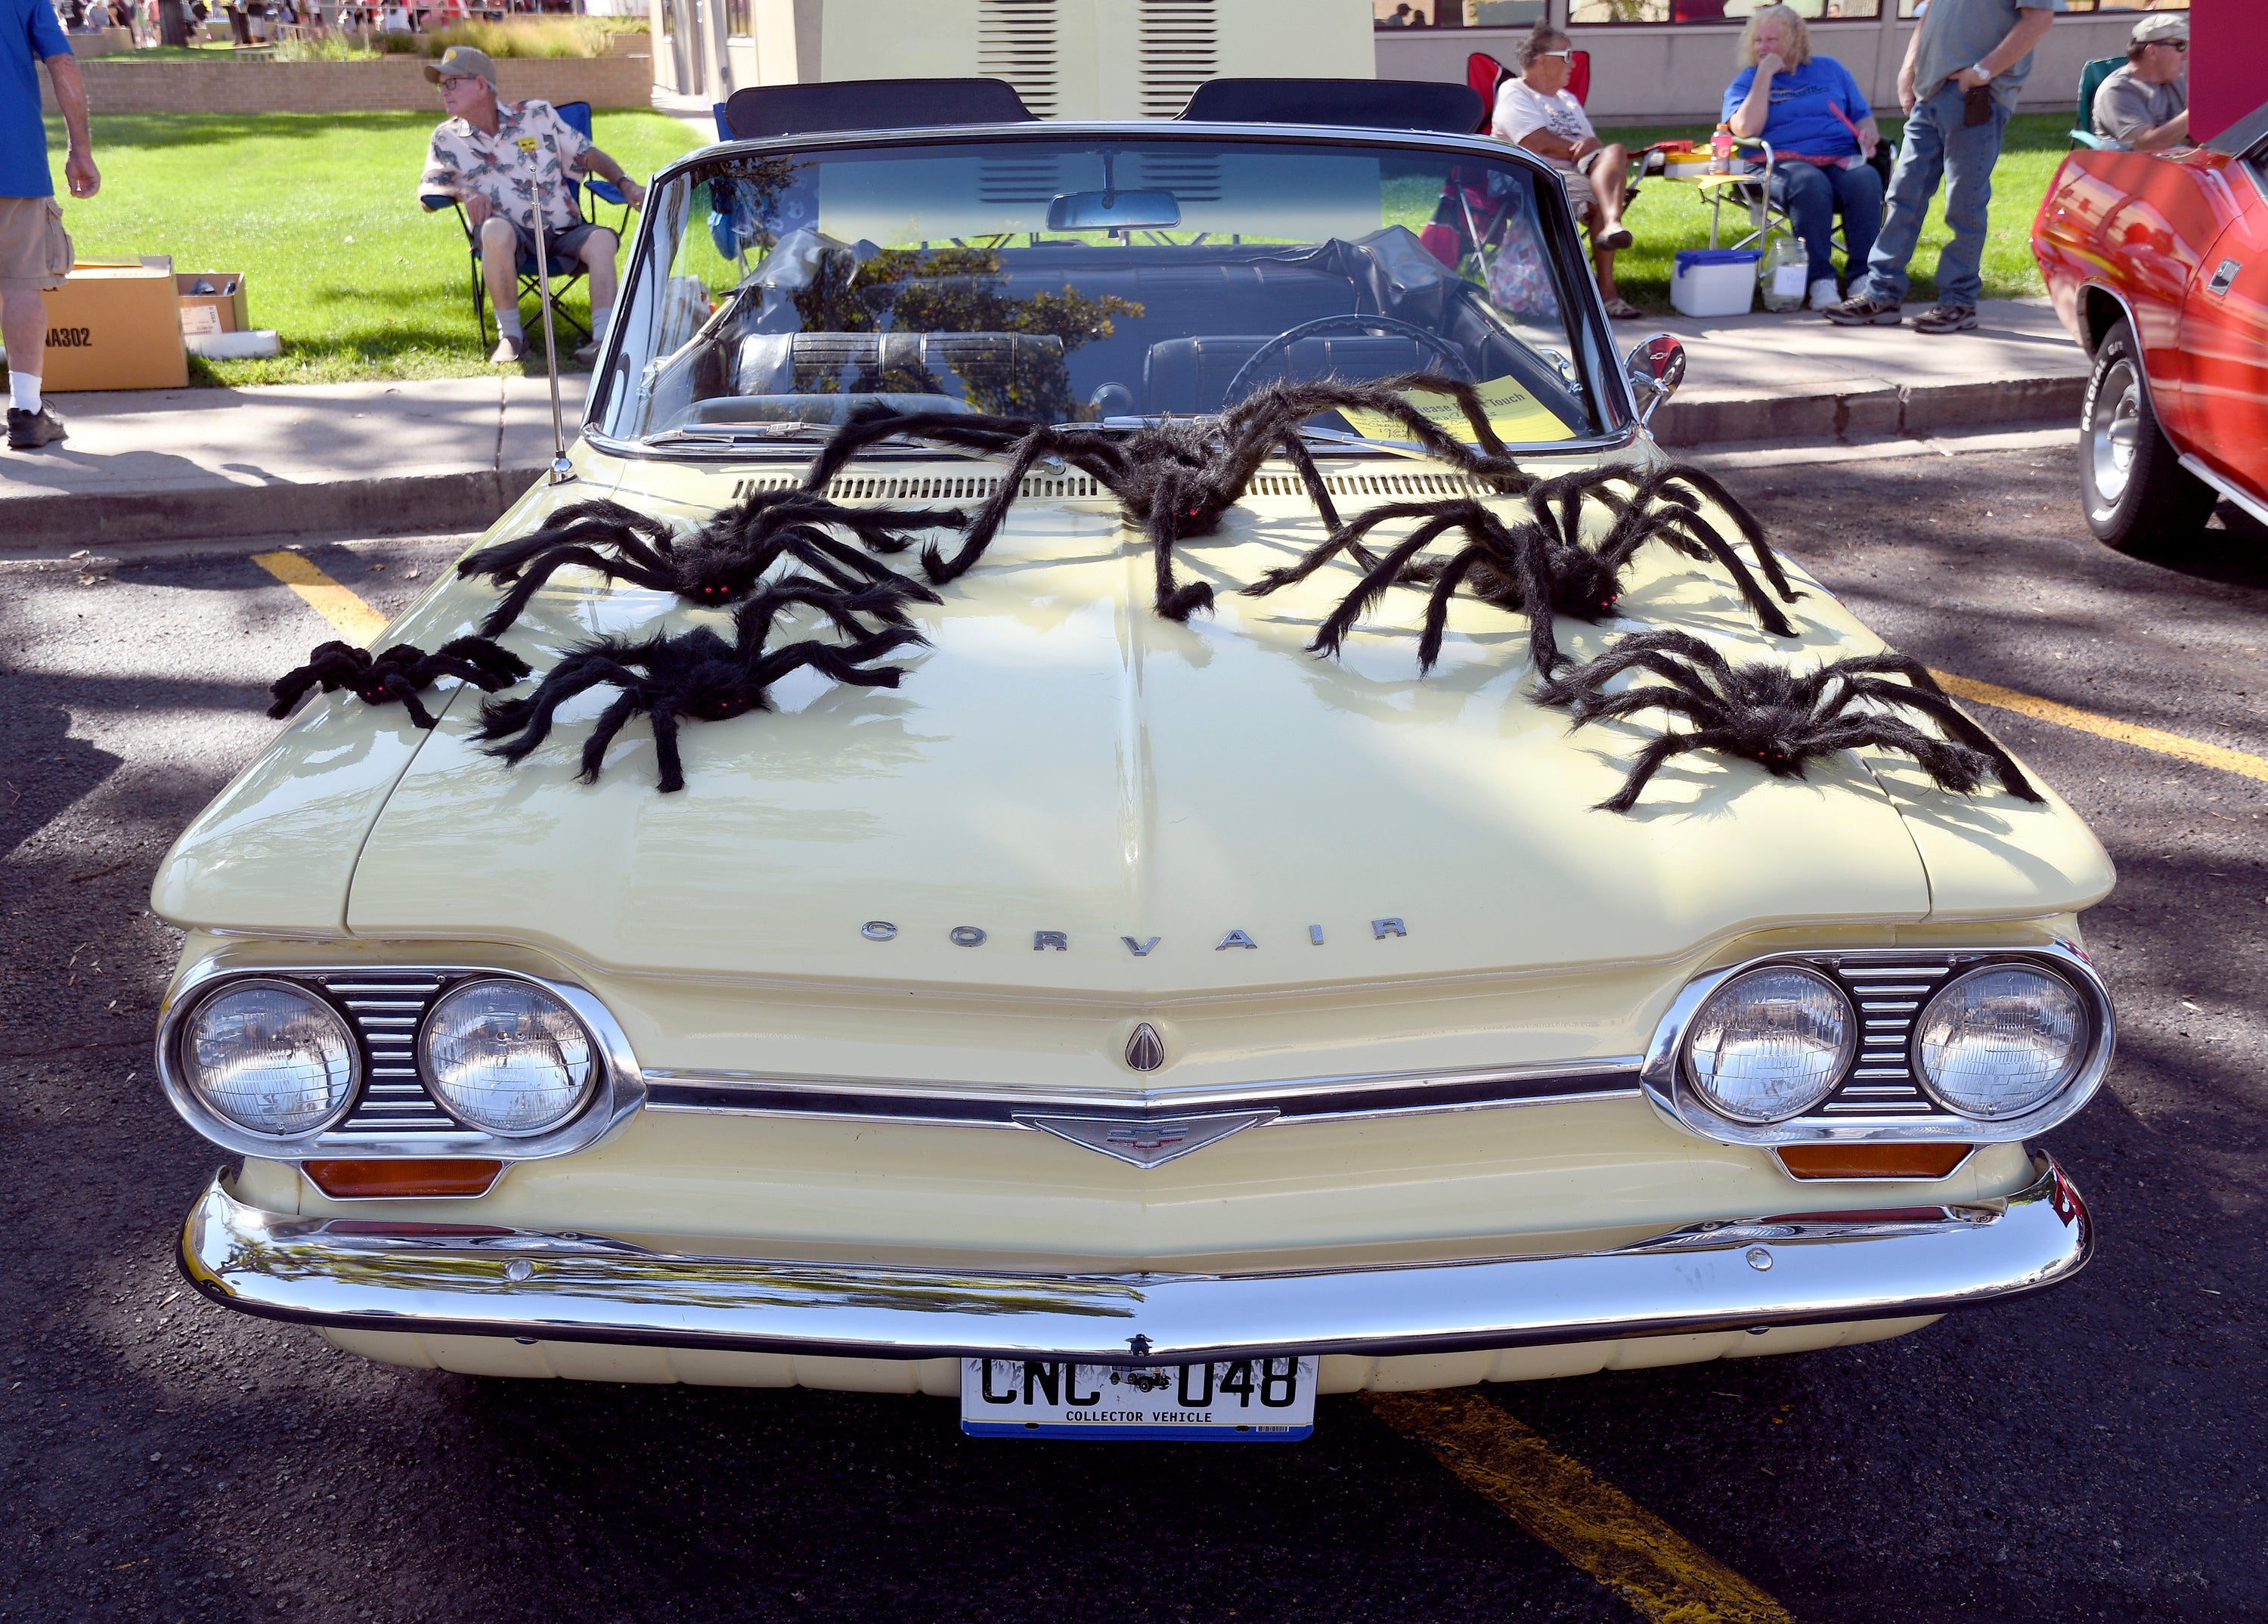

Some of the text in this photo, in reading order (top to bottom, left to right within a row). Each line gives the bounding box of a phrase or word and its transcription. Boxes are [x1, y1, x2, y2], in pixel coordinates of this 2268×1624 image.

[1418, 404, 1452, 414] lease
[1488, 392, 1526, 407] Touch
[2081, 358, 2108, 432] RADIAL
[860, 916, 1408, 957] CORVAIR
[1065, 1410, 1213, 1423] COLLECTOR VEHICLE
